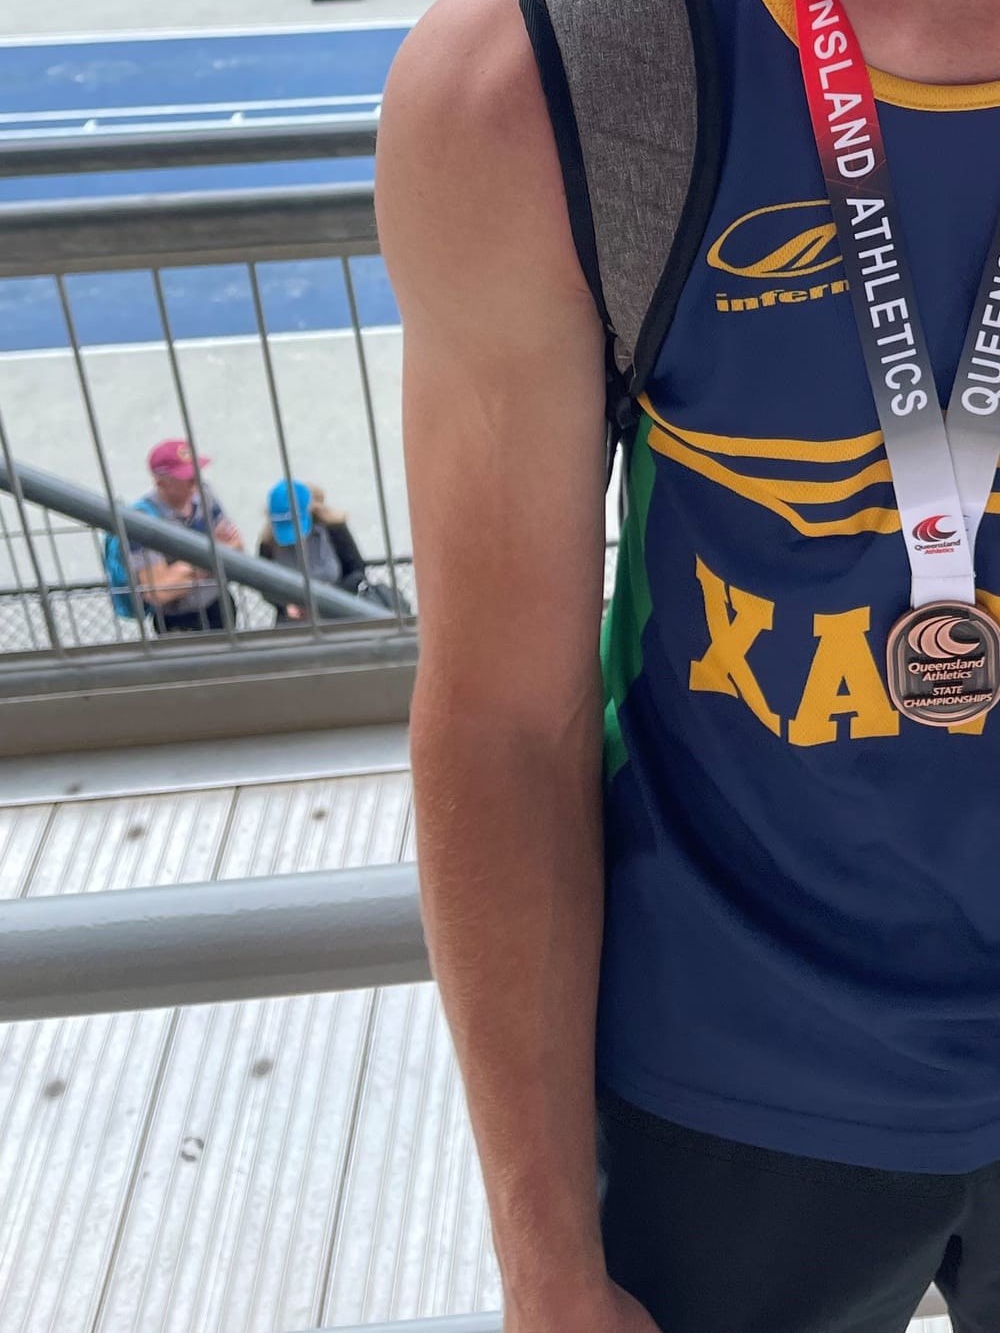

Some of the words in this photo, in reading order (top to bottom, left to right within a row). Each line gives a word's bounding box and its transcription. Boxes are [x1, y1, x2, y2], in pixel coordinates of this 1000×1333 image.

[846, 195, 927, 416] ATHLETICS
[908, 657, 985, 674] Queensland
[922, 670, 972, 681] Athletics
[932, 686, 963, 696] STATE
[903, 693, 993, 708] CHAMPIONSHIPS
